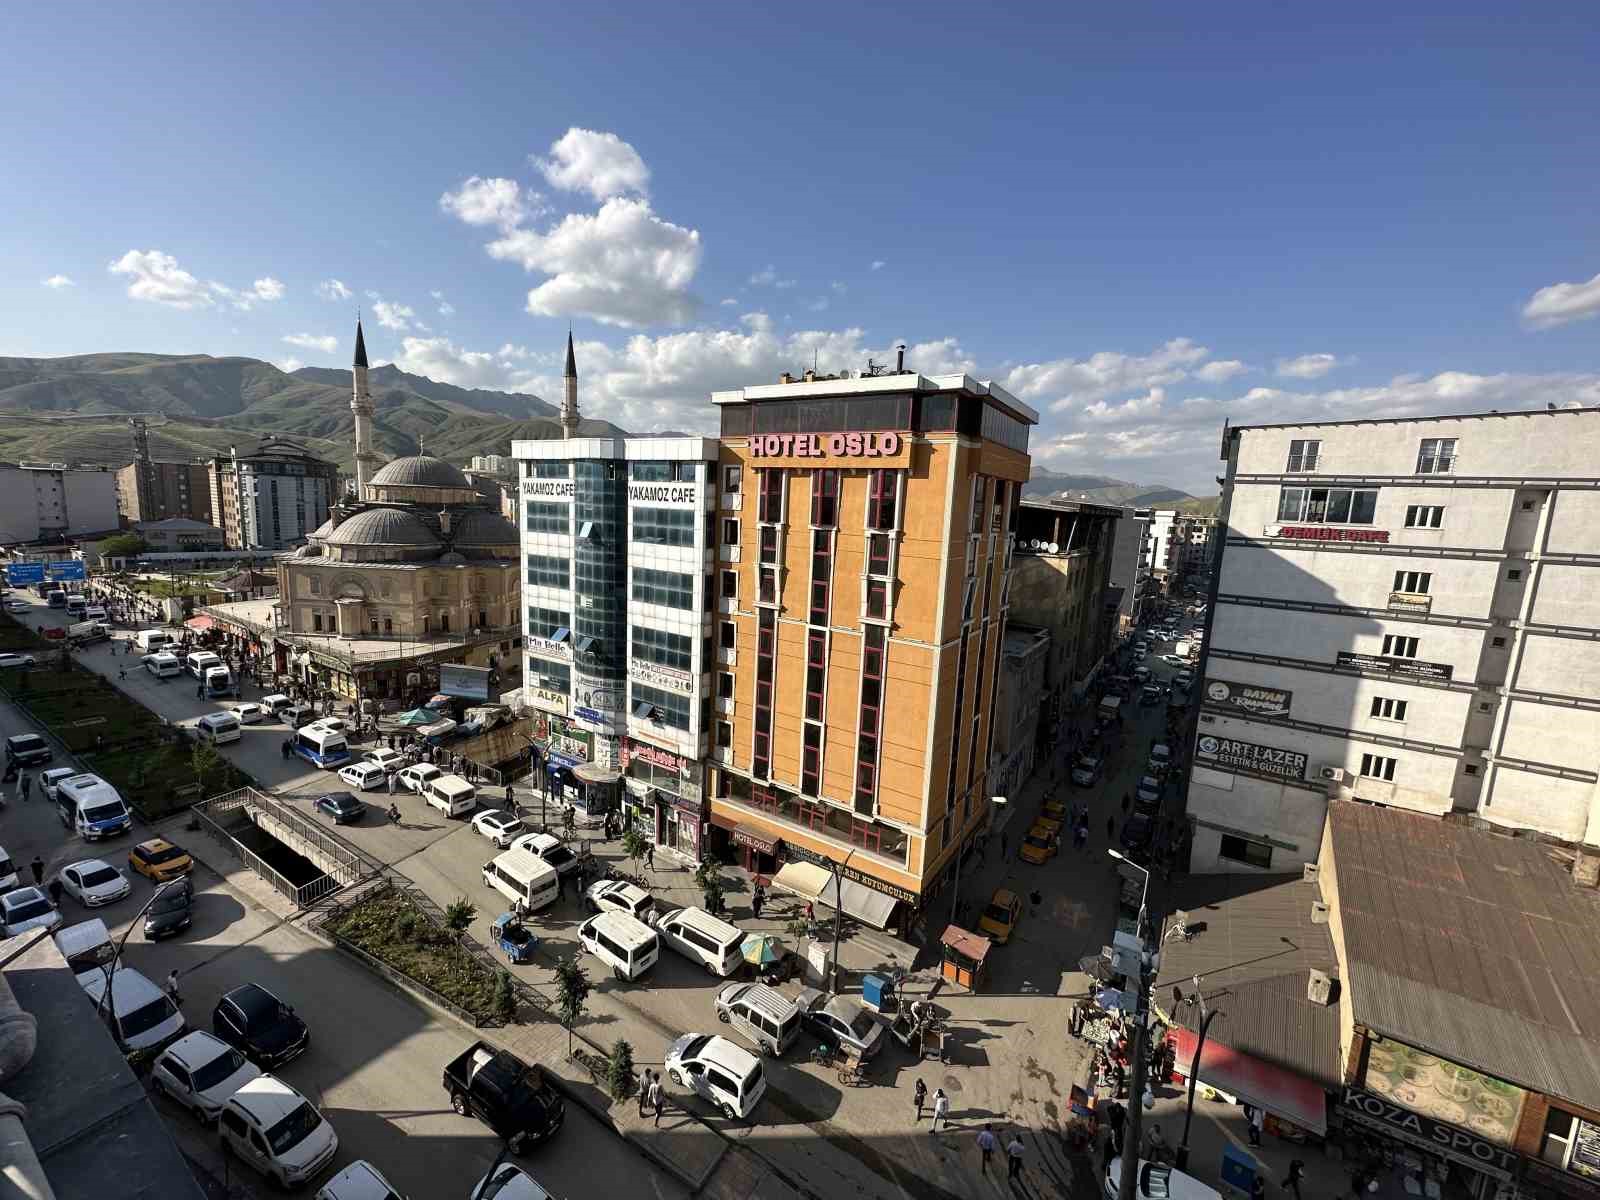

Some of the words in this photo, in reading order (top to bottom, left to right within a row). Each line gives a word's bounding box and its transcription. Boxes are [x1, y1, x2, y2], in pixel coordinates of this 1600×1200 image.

[750, 433, 821, 457] HOTEL
[829, 431, 899, 456] OSLO
[522, 481, 554, 496] YAKAMOZ
[555, 484, 574, 497] CAFE
[628, 485, 669, 502] YAKAMOZ
[671, 487, 695, 503] CAFE
[537, 689, 564, 705] ALFA
[1220, 740, 1251, 757] ART
[1253, 746, 1305, 768] LAZER
[1251, 760, 1258, 770] &
[734, 831, 752, 845] HOTEL
[1344, 1088, 1423, 1134] KOZA
[1431, 1124, 1518, 1169] SPOT
